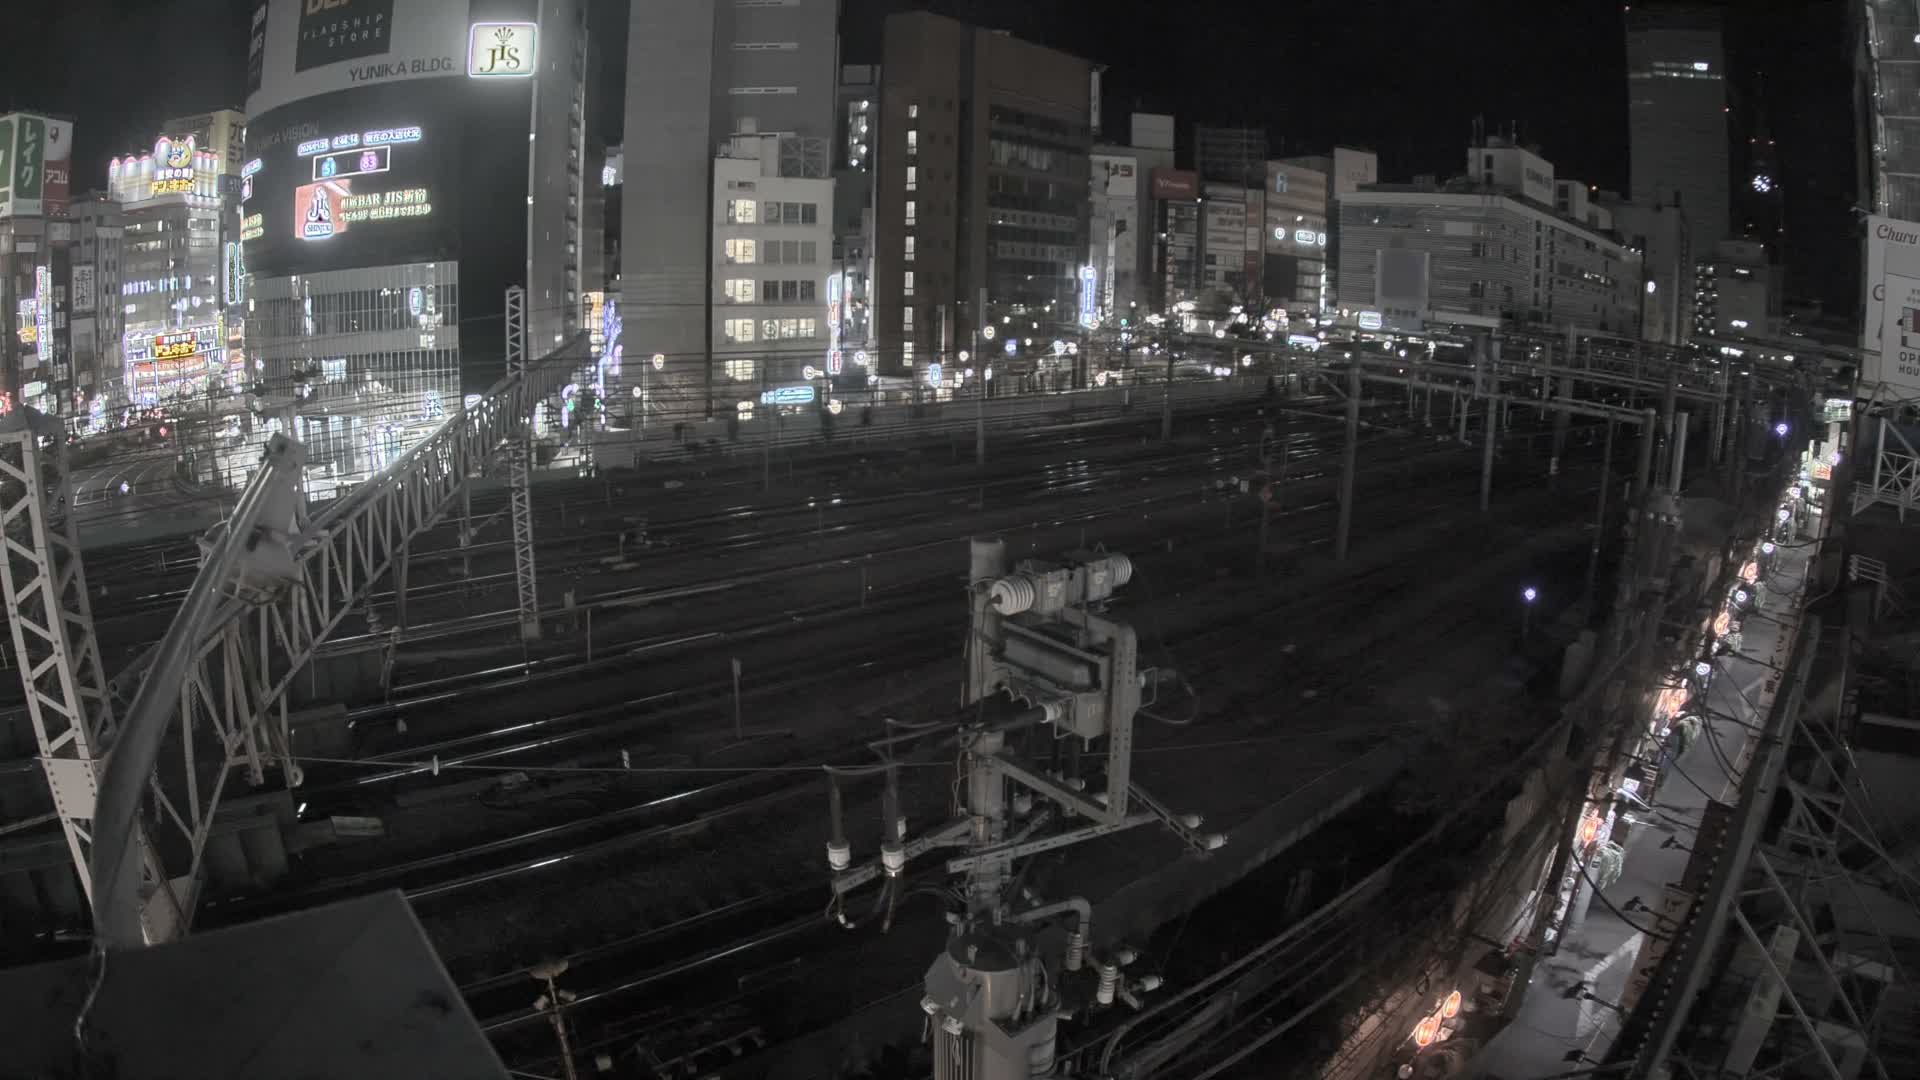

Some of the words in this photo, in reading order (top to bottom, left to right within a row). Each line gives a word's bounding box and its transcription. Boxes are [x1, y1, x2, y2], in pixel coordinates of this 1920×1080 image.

[328, 27, 382, 48] STORE
[350, 63, 407, 82] YUNIKA
[21, 120, 36, 187] レイク
[45, 168, 69, 185] アコム
[1900, 351, 1920, 365] OP
